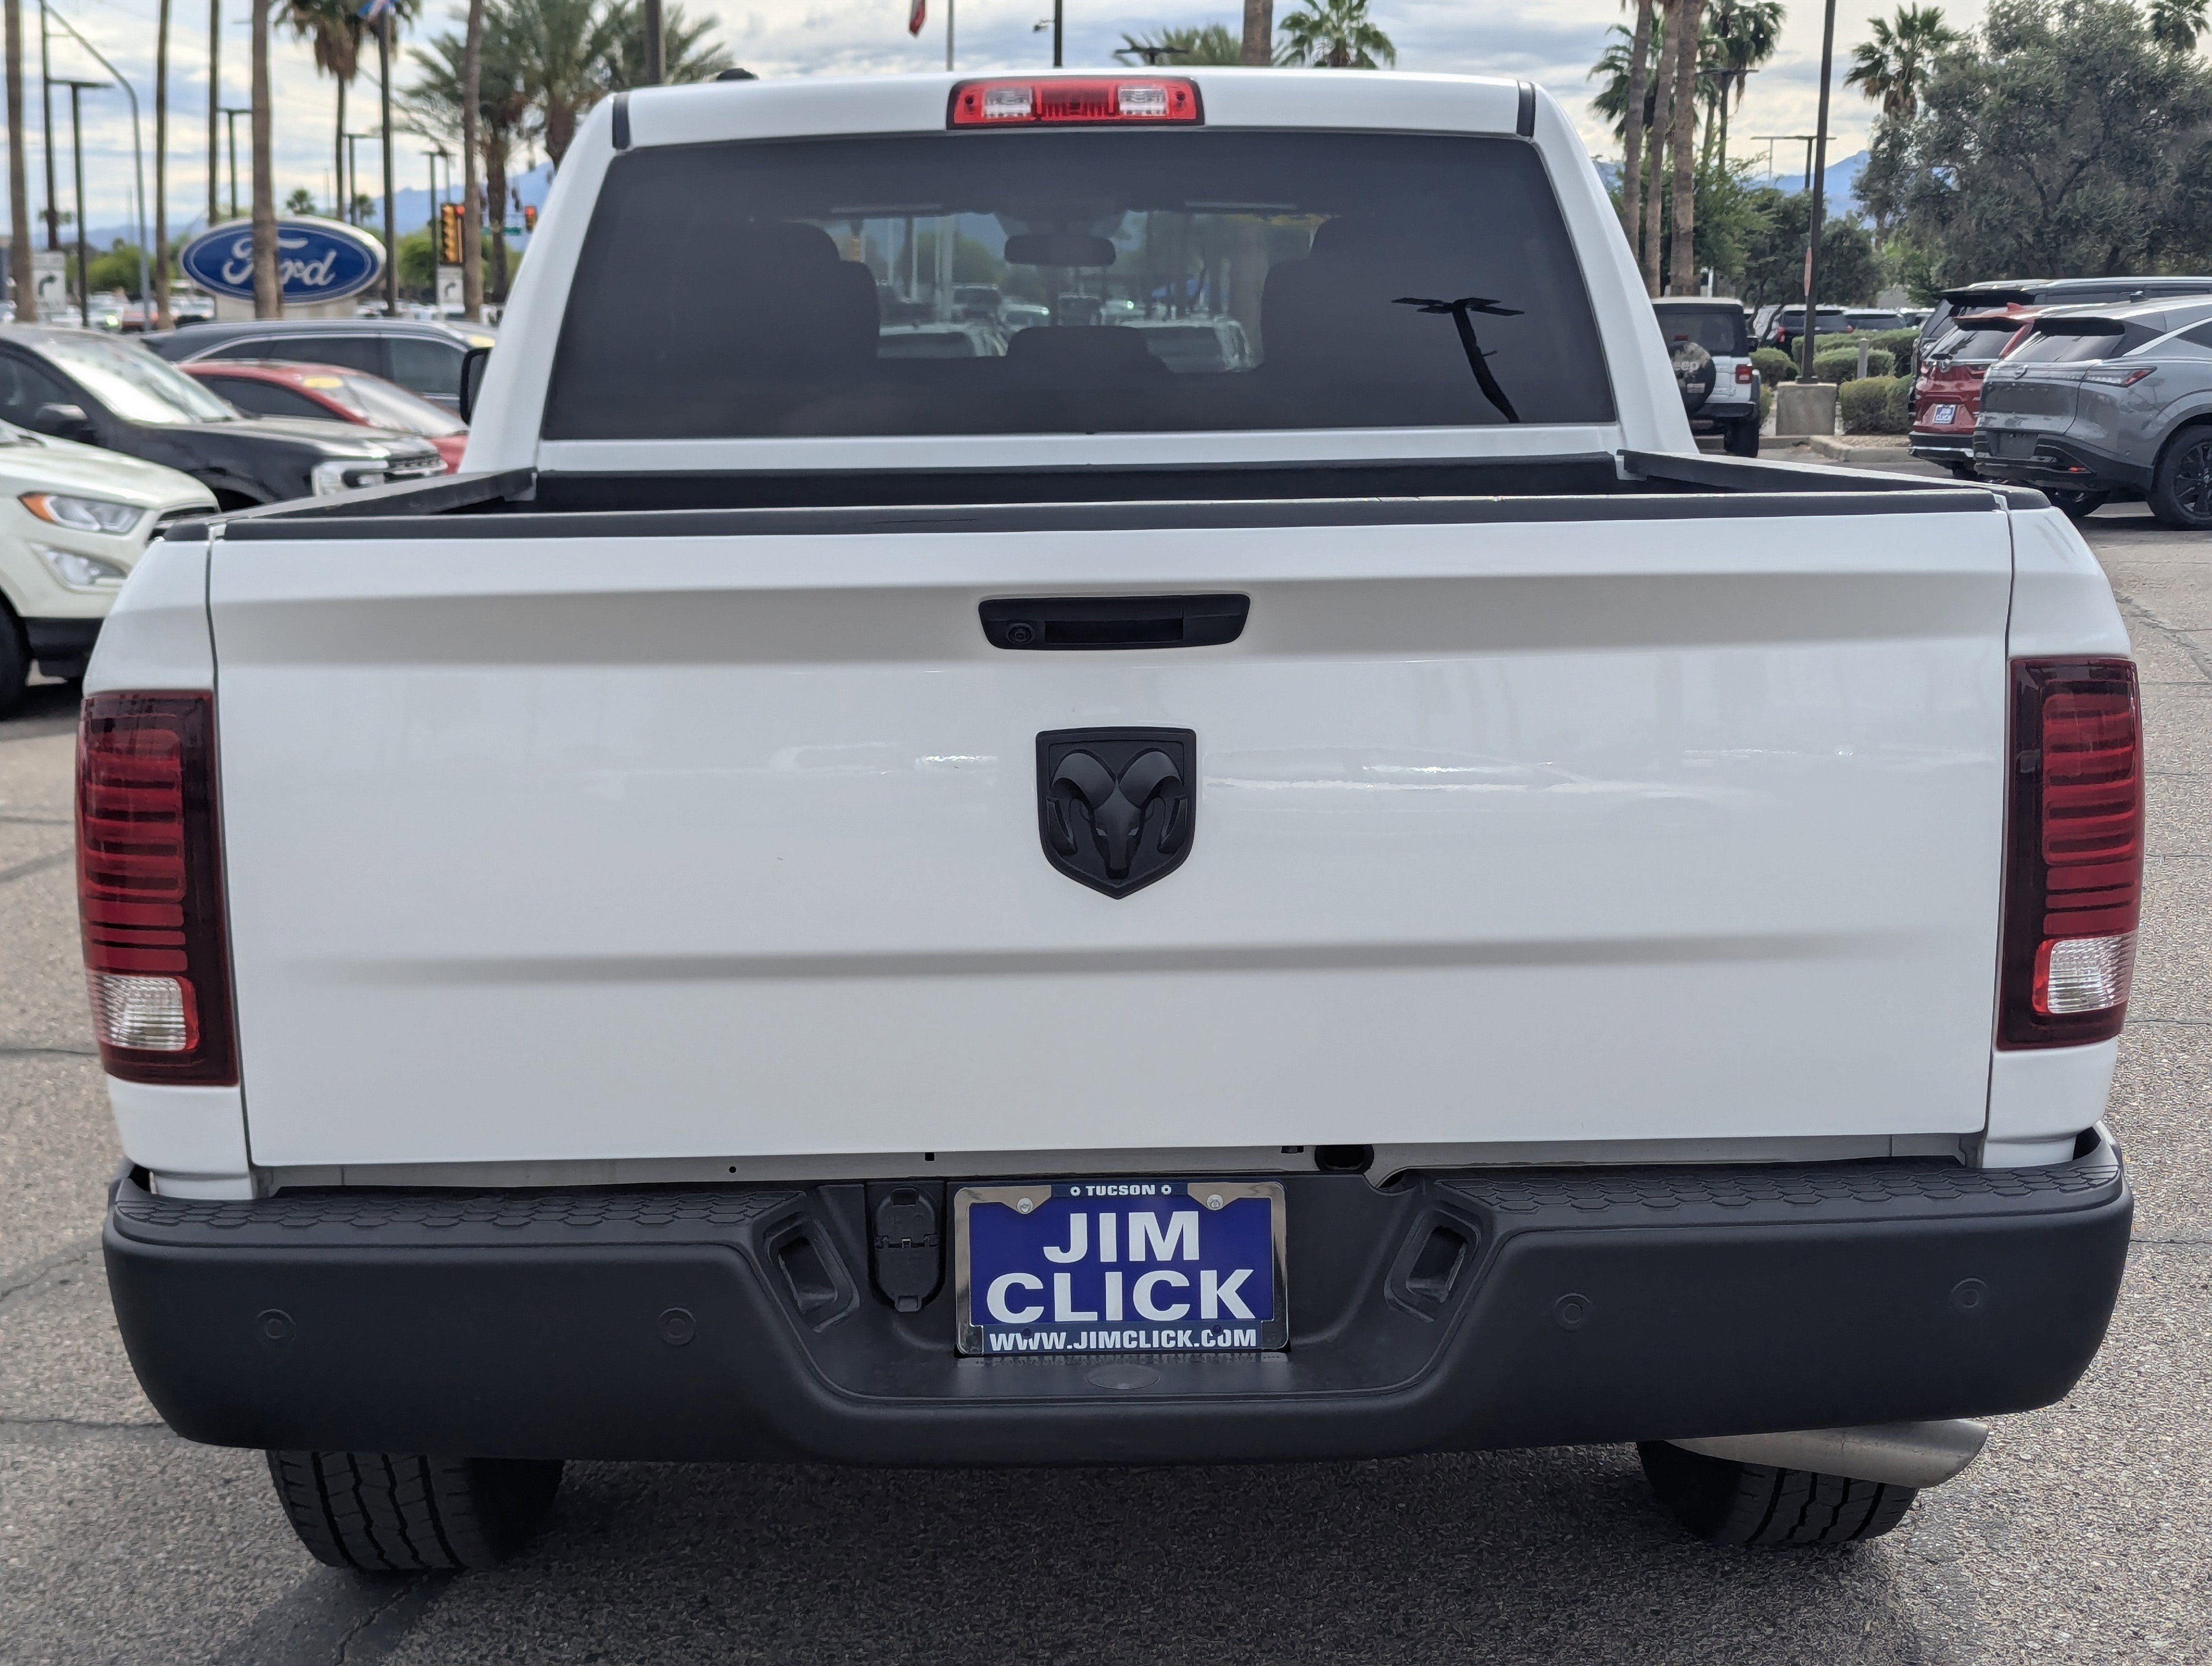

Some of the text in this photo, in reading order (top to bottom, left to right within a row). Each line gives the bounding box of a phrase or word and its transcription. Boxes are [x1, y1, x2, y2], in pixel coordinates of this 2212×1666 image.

[222, 237, 337, 285] Frd
[1085, 1184, 1155, 1196] TUCSON
[1043, 1210, 1200, 1264] JIM
[987, 1269, 1256, 1324] CLICK
[989, 1329, 1256, 1351] WWW.JIMCLICK.COM
